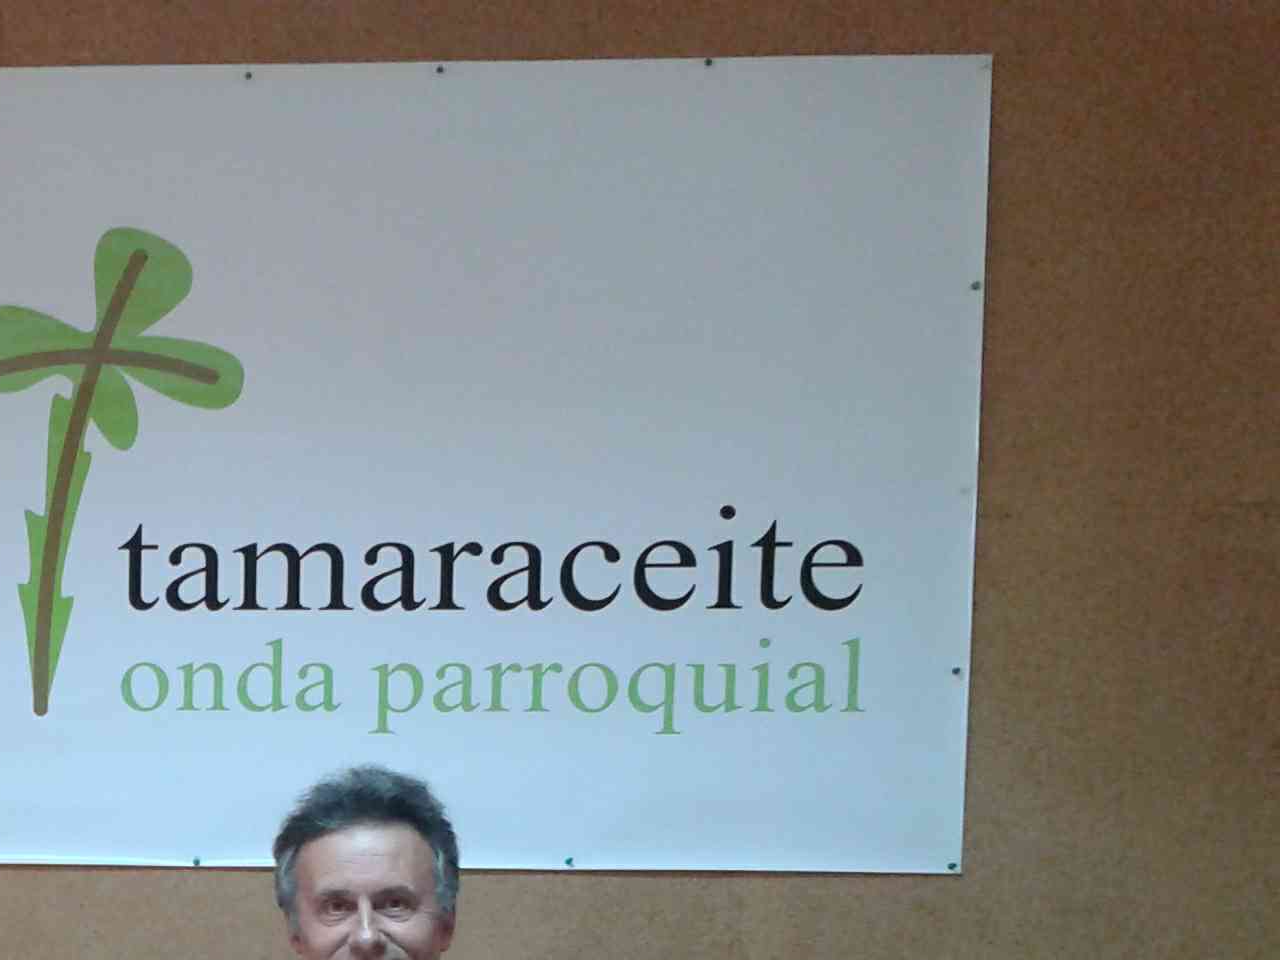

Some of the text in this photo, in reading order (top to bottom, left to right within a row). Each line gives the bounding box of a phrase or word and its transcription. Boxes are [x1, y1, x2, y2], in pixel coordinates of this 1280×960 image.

[117, 504, 865, 612] tamaraceite
[120, 636, 867, 735] onda parroquial
